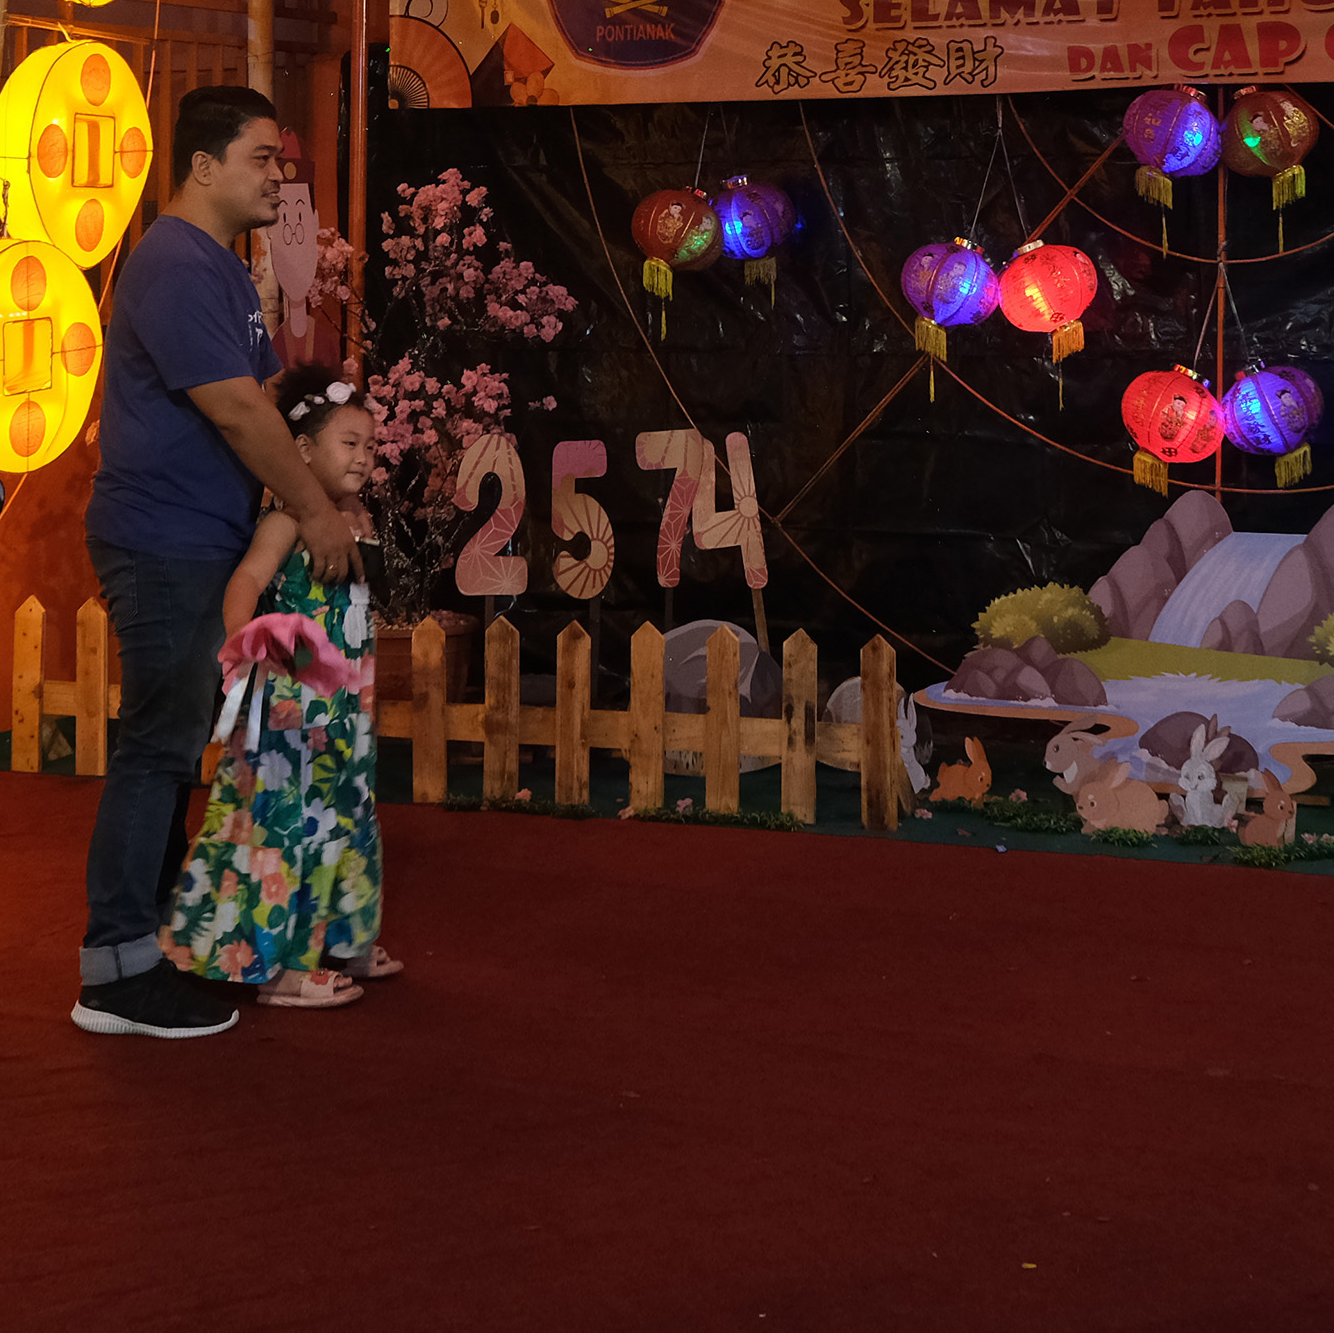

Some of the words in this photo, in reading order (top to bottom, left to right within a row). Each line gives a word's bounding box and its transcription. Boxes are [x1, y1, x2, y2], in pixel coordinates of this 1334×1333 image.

[595, 23, 676, 43] PONTIANAK
[1067, 41, 1158, 81] DAN
[1167, 14, 1308, 79] CAP
[754, 37, 1005, 95] 恭喜發財
[451, 427, 769, 601] 2574
